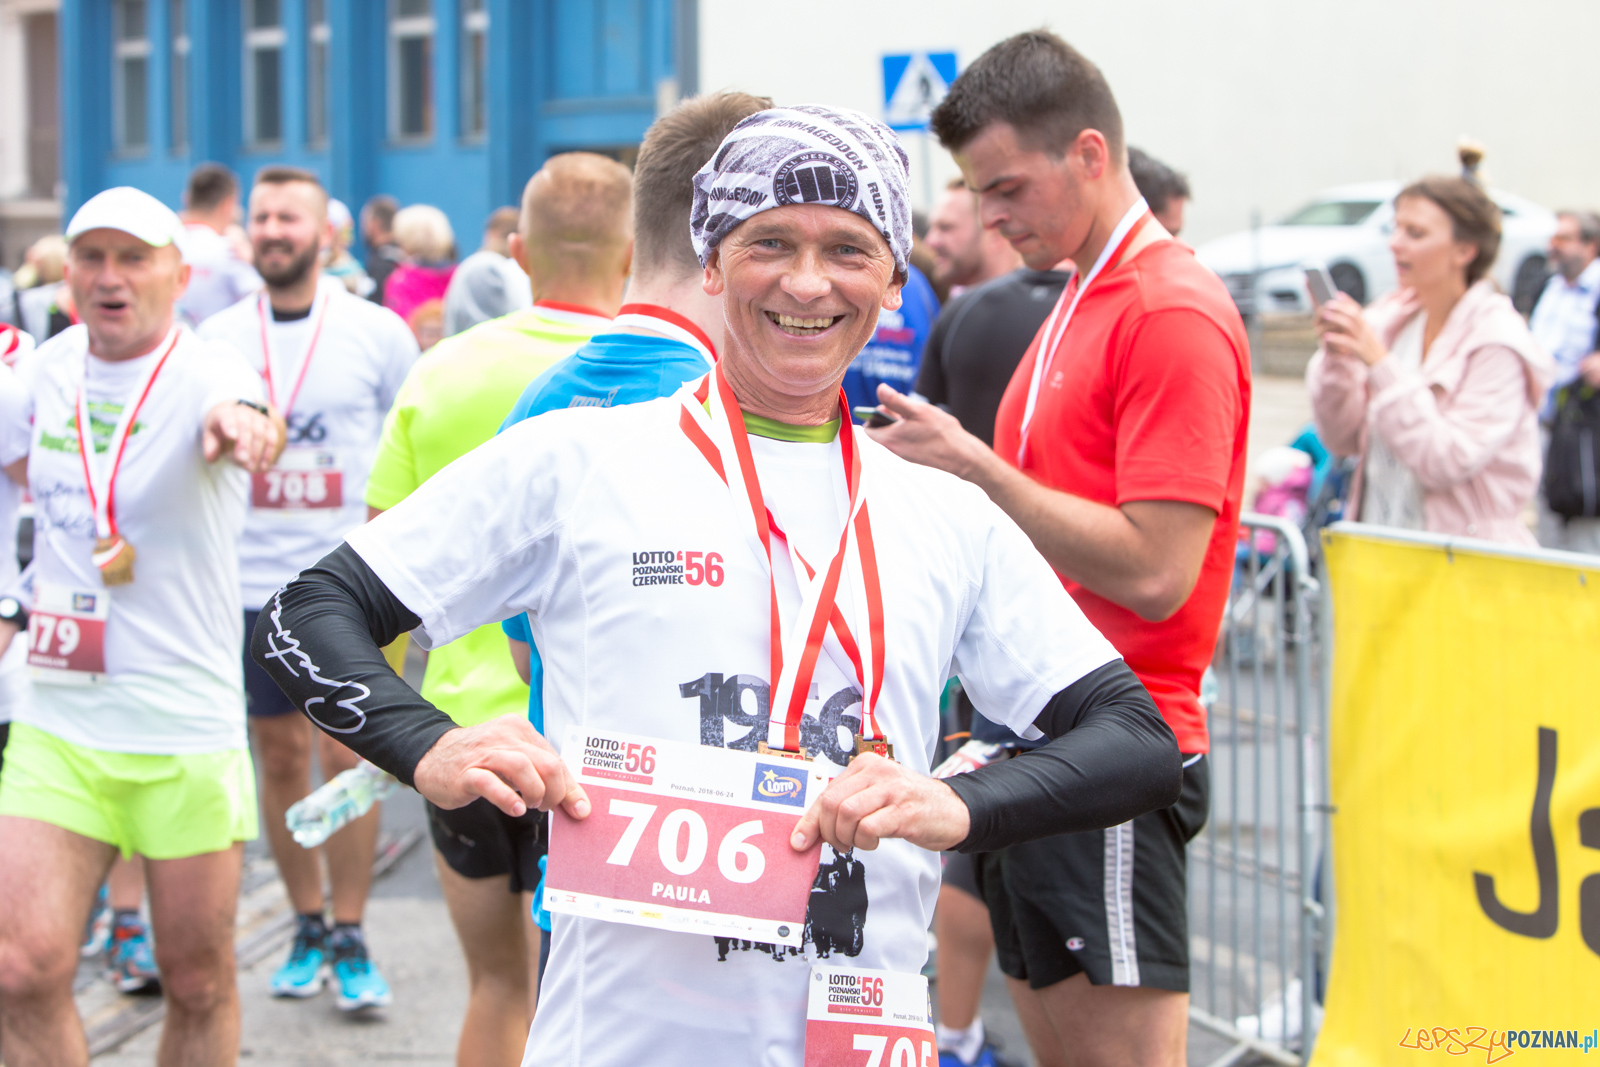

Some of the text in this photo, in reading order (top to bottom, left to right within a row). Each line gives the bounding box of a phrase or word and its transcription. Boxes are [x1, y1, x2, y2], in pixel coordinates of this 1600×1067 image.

[778, 158, 798, 180] BULL
[800, 153, 832, 161] WEST
[834, 160, 856, 187] COAST
[632, 551, 675, 565] LOTTO
[632, 563, 684, 576] POZNAŃSKI
[632, 575, 684, 587] CZERWIEC
[586, 736, 619, 752] LOTTO
[584, 748, 624, 762] POZNAŃSKI
[583, 757, 623, 770] CZERWIEC
[671, 783, 734, 798] Poznań, 2018-06-24
[767, 780, 794, 793] LOTTO
[606, 799, 766, 884] 706
[651, 882, 711, 904] PAULA
[829, 974, 856, 986] LOTTO
[828, 985, 860, 995] POZNAŃSKI
[828, 994, 860, 1004] CZERWIEC
